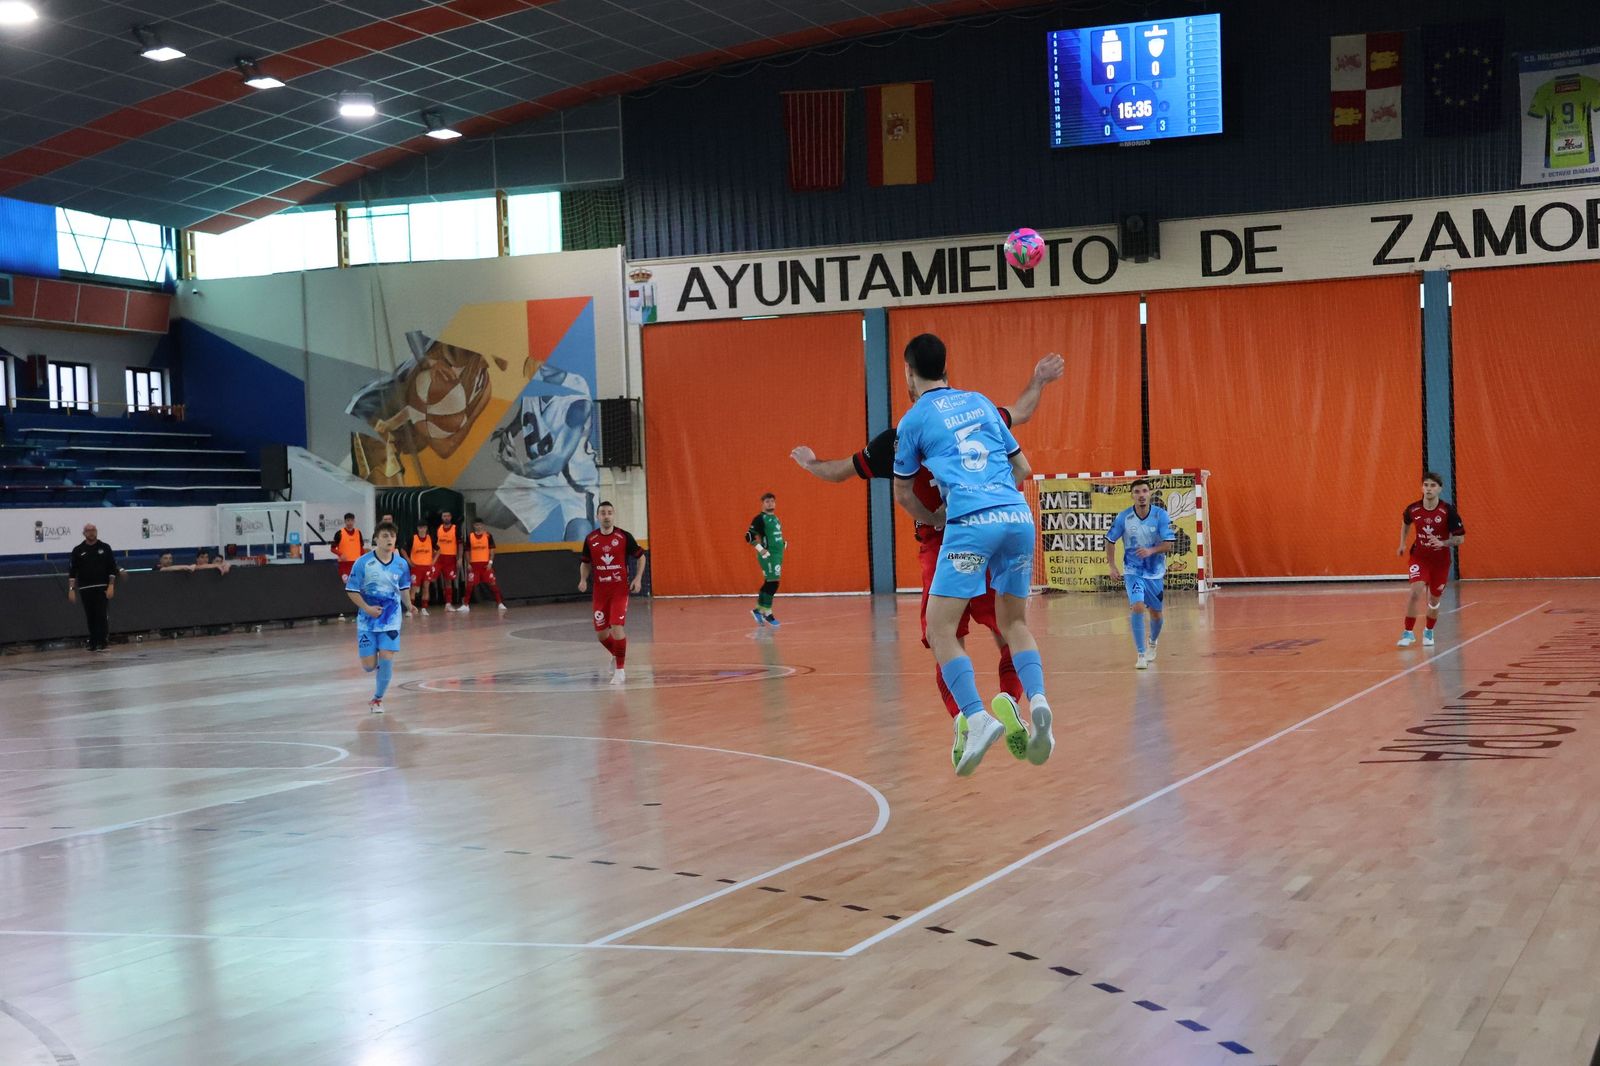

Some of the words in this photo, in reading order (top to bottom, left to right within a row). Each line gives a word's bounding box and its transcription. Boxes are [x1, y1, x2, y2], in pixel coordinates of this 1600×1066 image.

[1106, 64, 1115, 80] 0
[1151, 60, 1160, 76] 0
[1131, 86, 1136, 96] 1
[1562, 102, 1574, 124] 9
[1104, 124, 1111, 136] 0
[1159, 119, 1166, 131] 3
[677, 234, 1118, 312] AYUNTAMIENTO
[1200, 224, 1283, 277] DE
[954, 423, 990, 473] 5
[1045, 491, 1087, 509] MIEL
[1047, 512, 1112, 530] MONTE
[45, 526, 71, 537] ZAMORA
[1051, 533, 1104, 551] ALISTE
[1079, 566, 1084, 575] Y
[1359, 690, 1600, 764] ZAMORA
